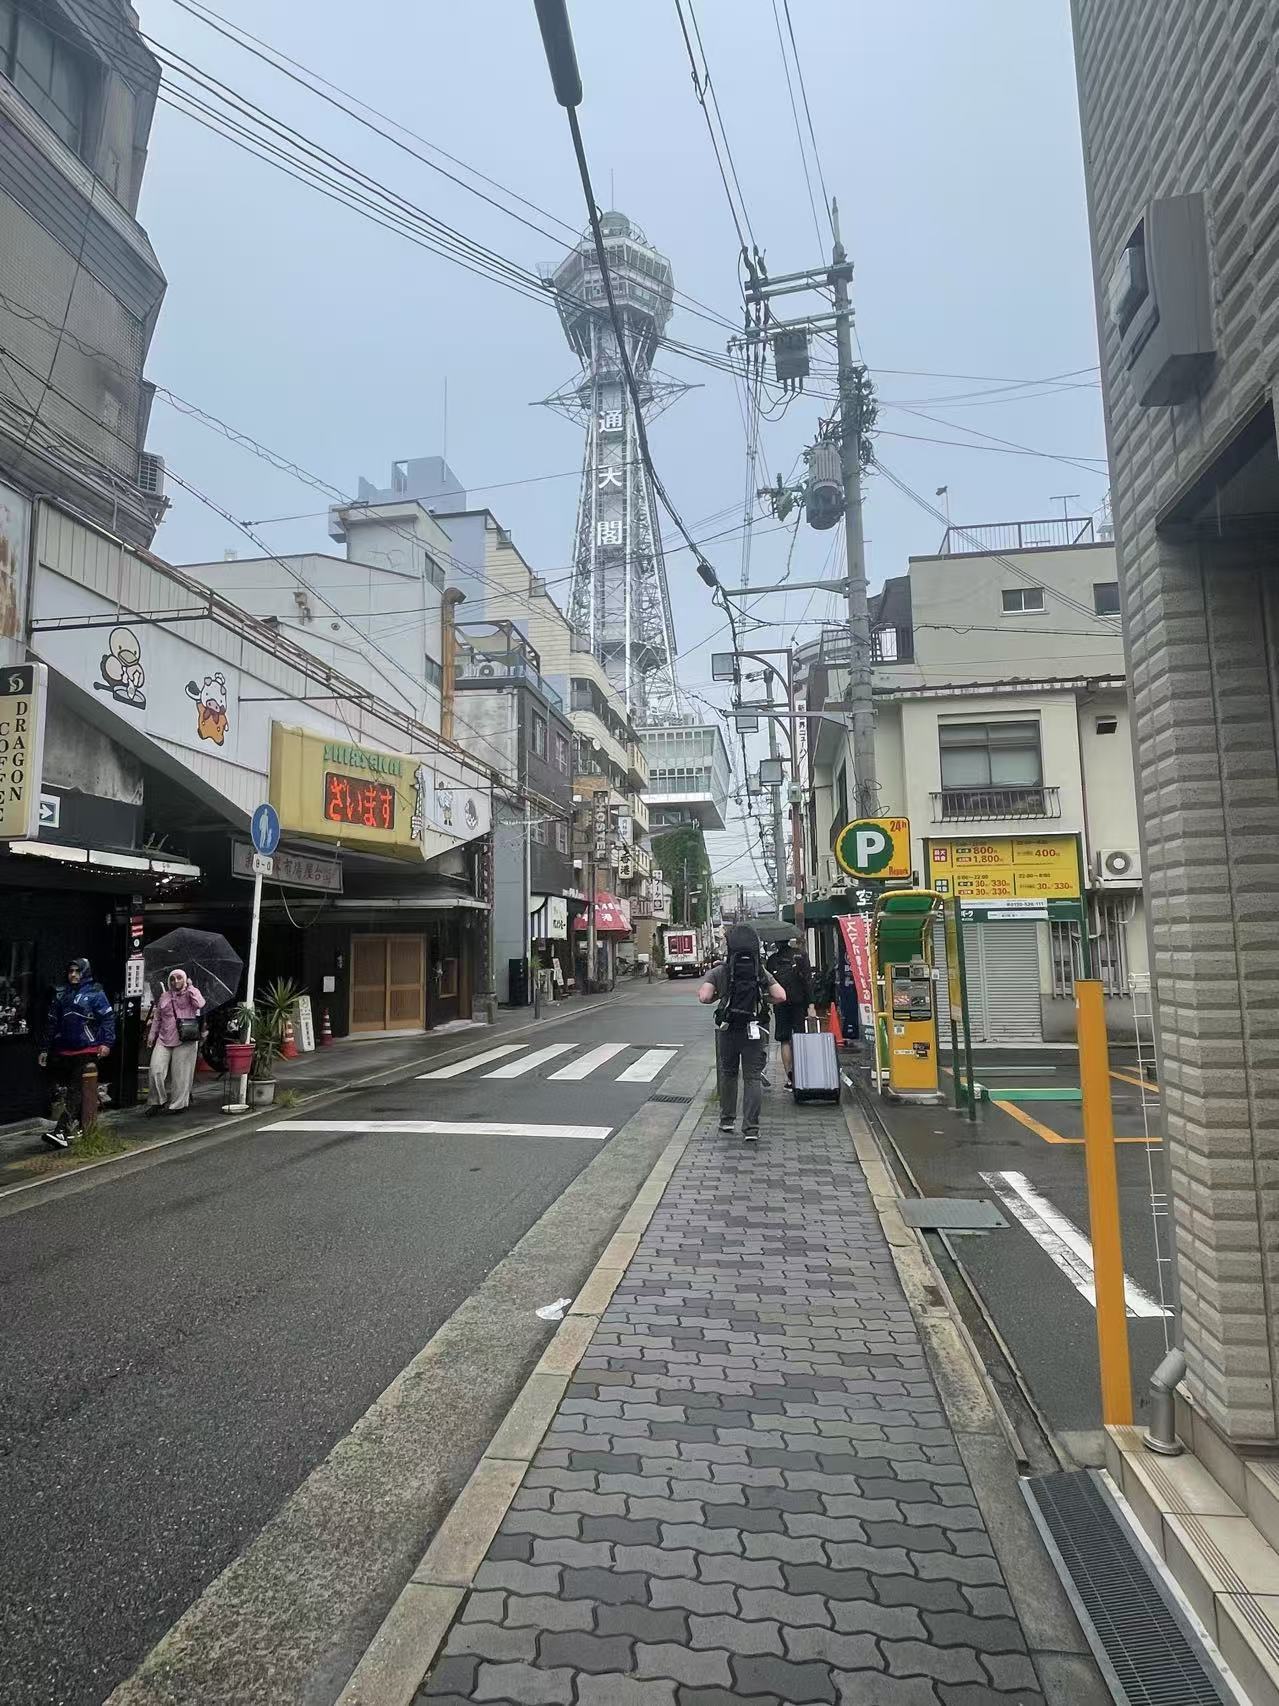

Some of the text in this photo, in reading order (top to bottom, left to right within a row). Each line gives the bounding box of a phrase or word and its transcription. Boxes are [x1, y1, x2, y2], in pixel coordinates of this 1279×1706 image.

[597, 410, 623, 546] 通天閣
[10, 702, 27, 801] DRAGON
[329, 777, 393, 828] ざいます
[890, 821, 906, 832] 24h
[856, 831, 885, 867] P
